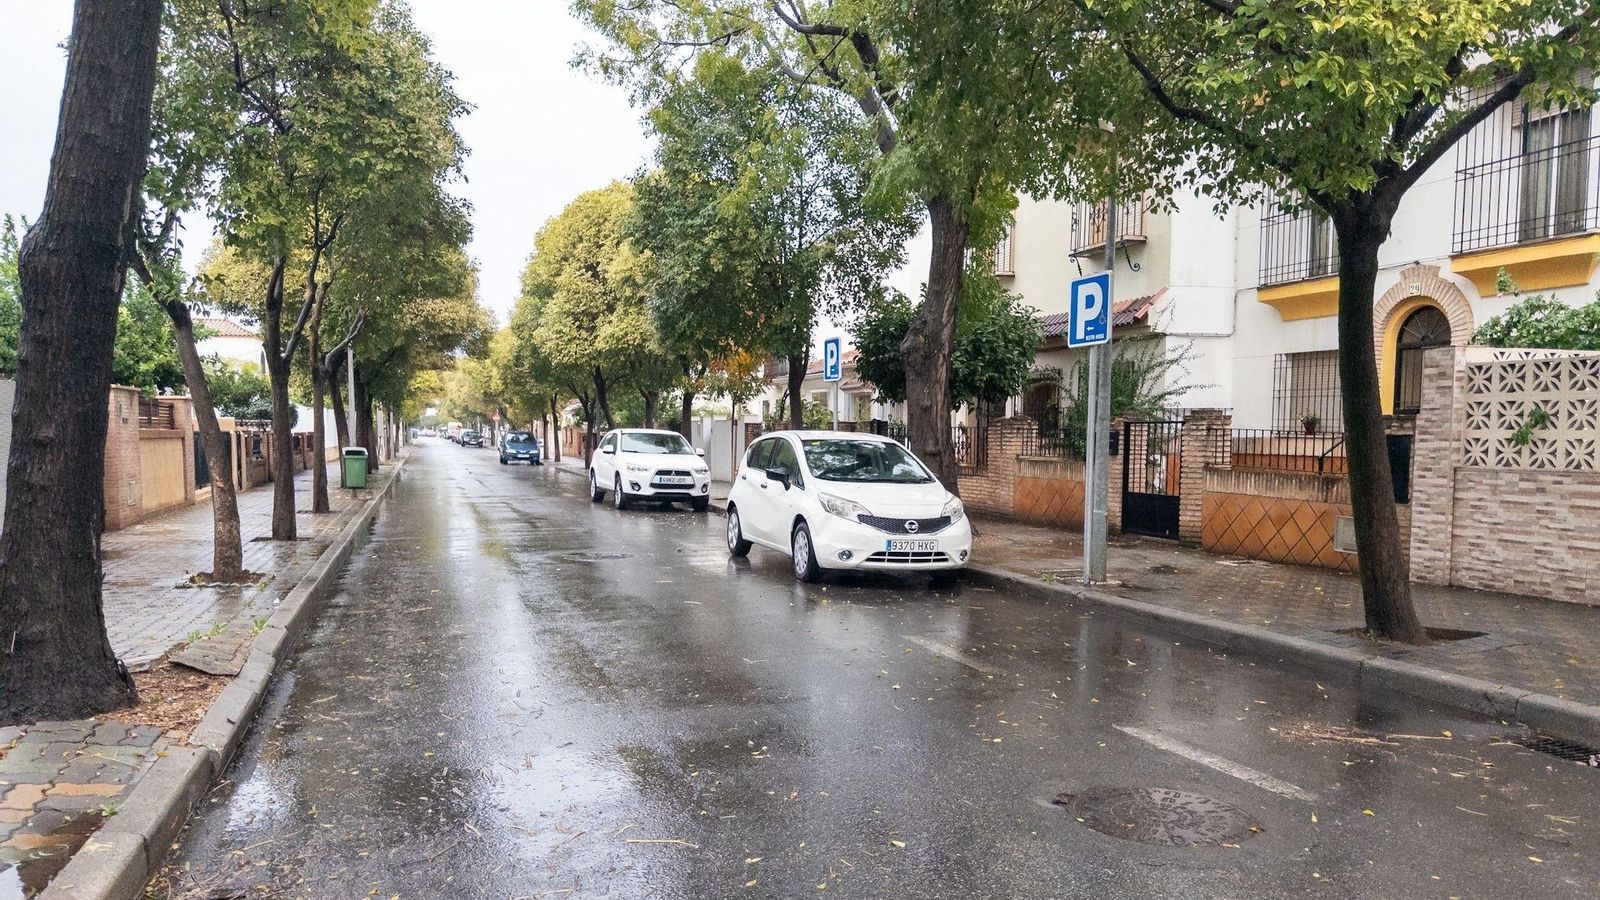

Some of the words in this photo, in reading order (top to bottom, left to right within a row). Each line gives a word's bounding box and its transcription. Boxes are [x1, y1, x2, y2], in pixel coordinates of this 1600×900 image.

[1410, 284, 1420, 295] 29
[1076, 282, 1103, 340] P
[827, 342, 837, 377] P
[892, 541, 915, 551] 9370
[918, 541, 935, 551] HXG
